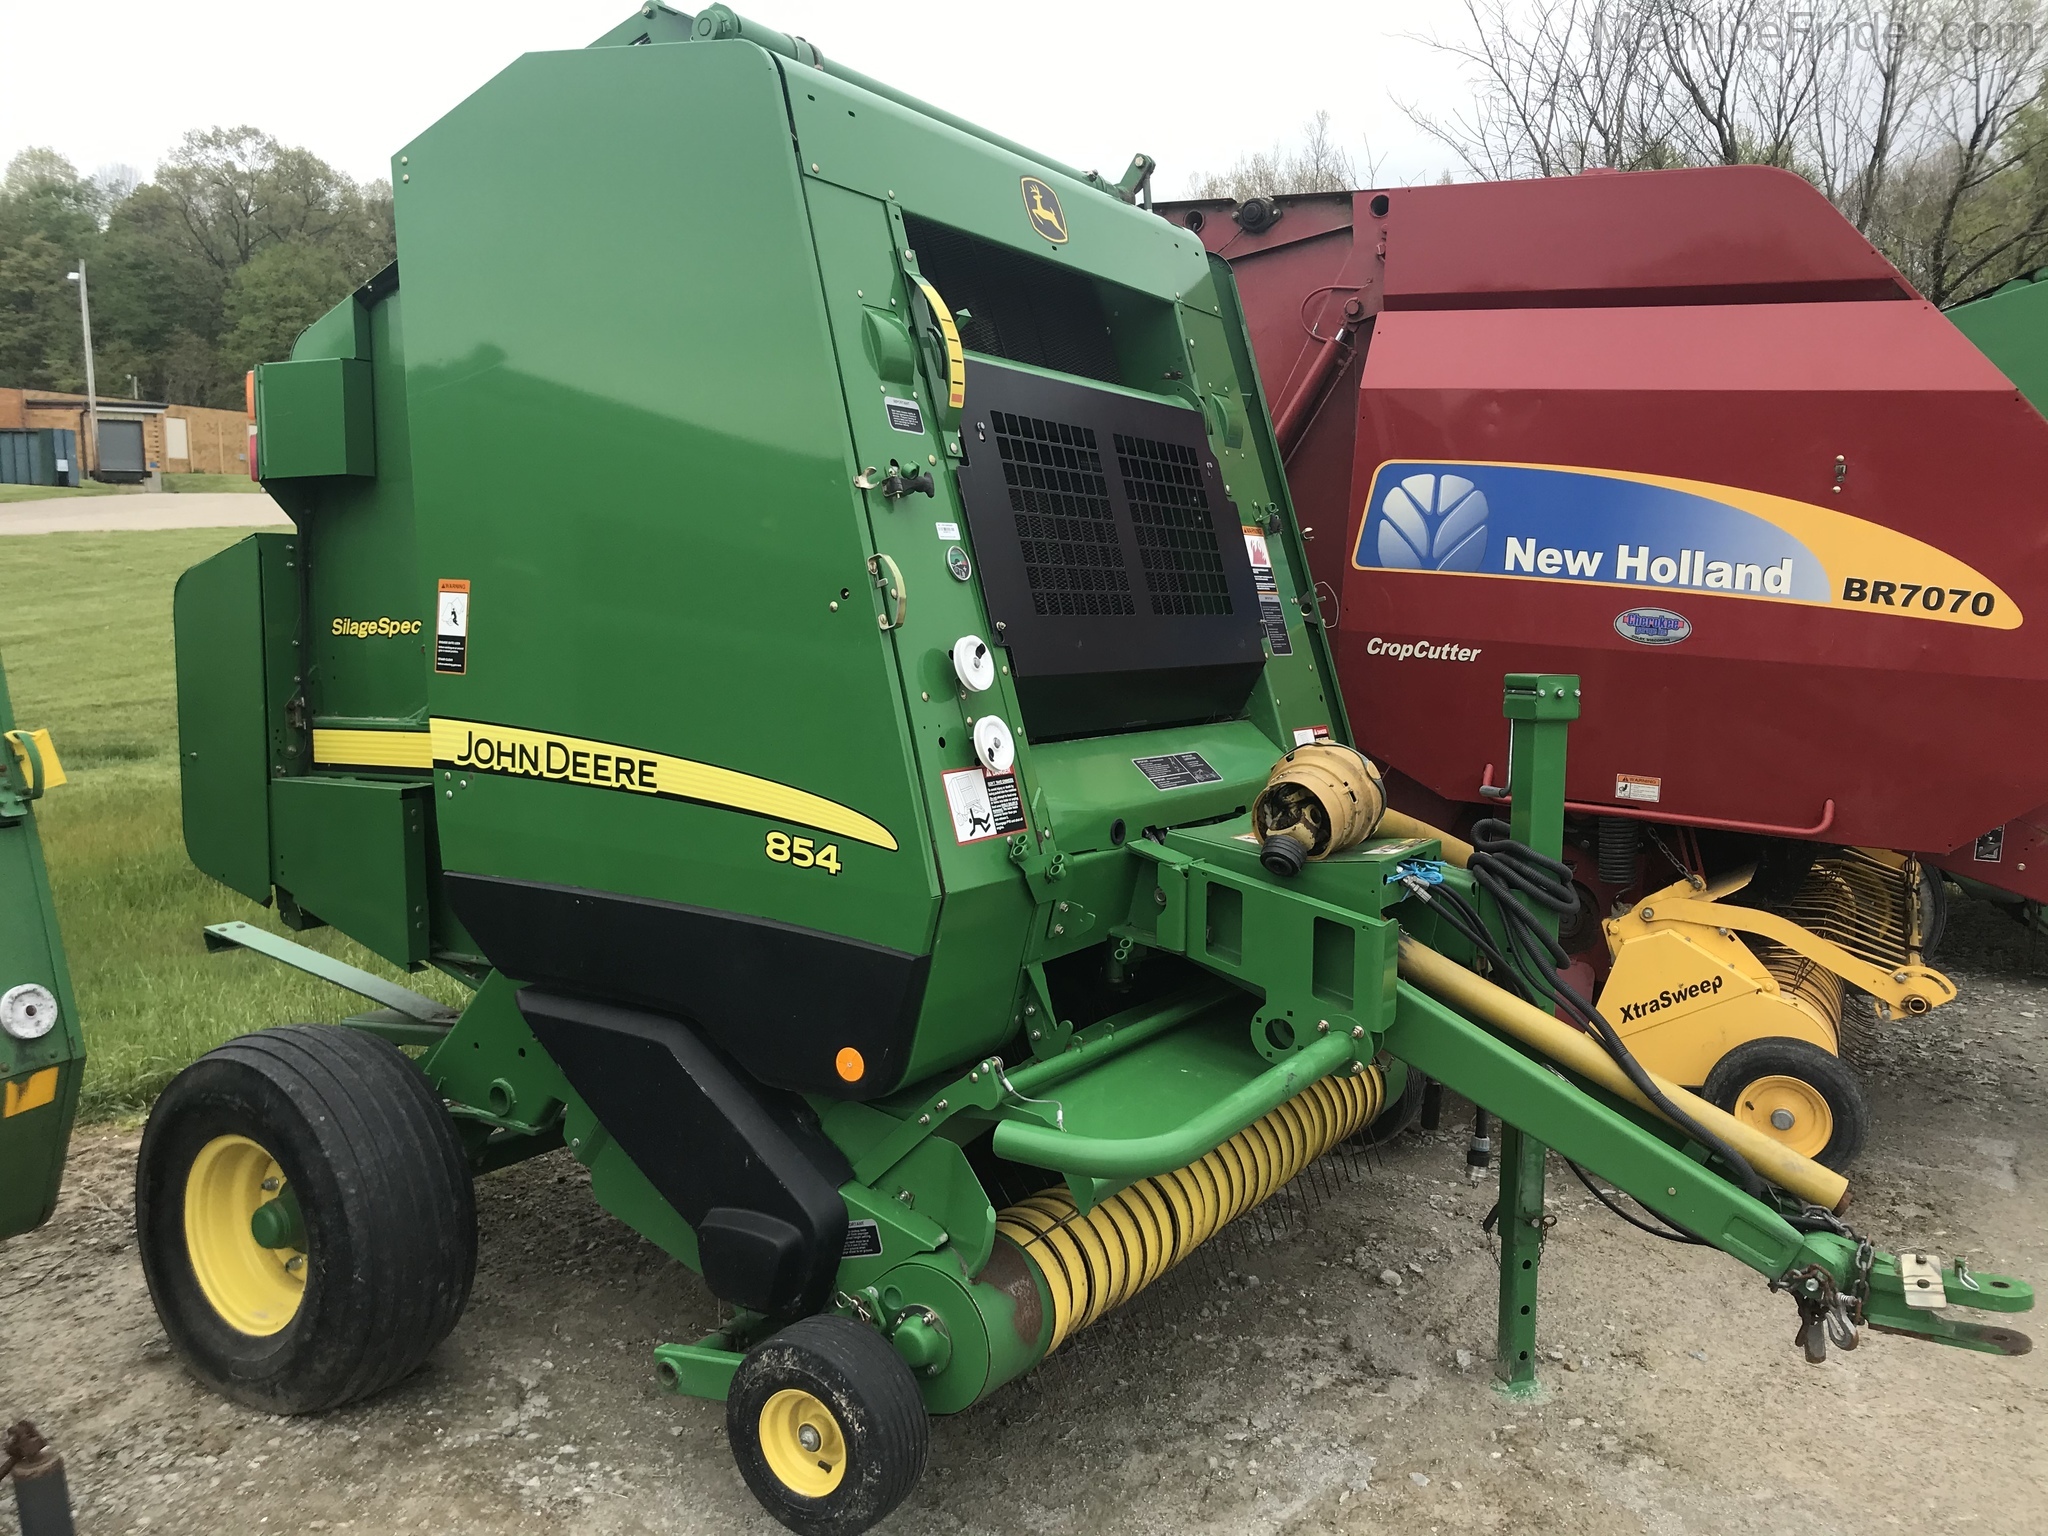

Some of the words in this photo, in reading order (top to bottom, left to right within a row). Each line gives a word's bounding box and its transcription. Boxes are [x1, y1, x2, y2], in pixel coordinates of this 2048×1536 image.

[1504, 536, 1604, 577] New
[1615, 543, 1794, 595] Holland
[1842, 577, 1995, 617] BR7070
[331, 616, 423, 639] SilageSpec
[1627, 613, 1680, 631] Cherokee
[1366, 637, 1482, 662] CropCutter
[457, 731, 539, 772] JOHN
[546, 741, 658, 789] DEERE
[765, 830, 843, 877] 854
[1619, 975, 1723, 1024] XtraSweep
